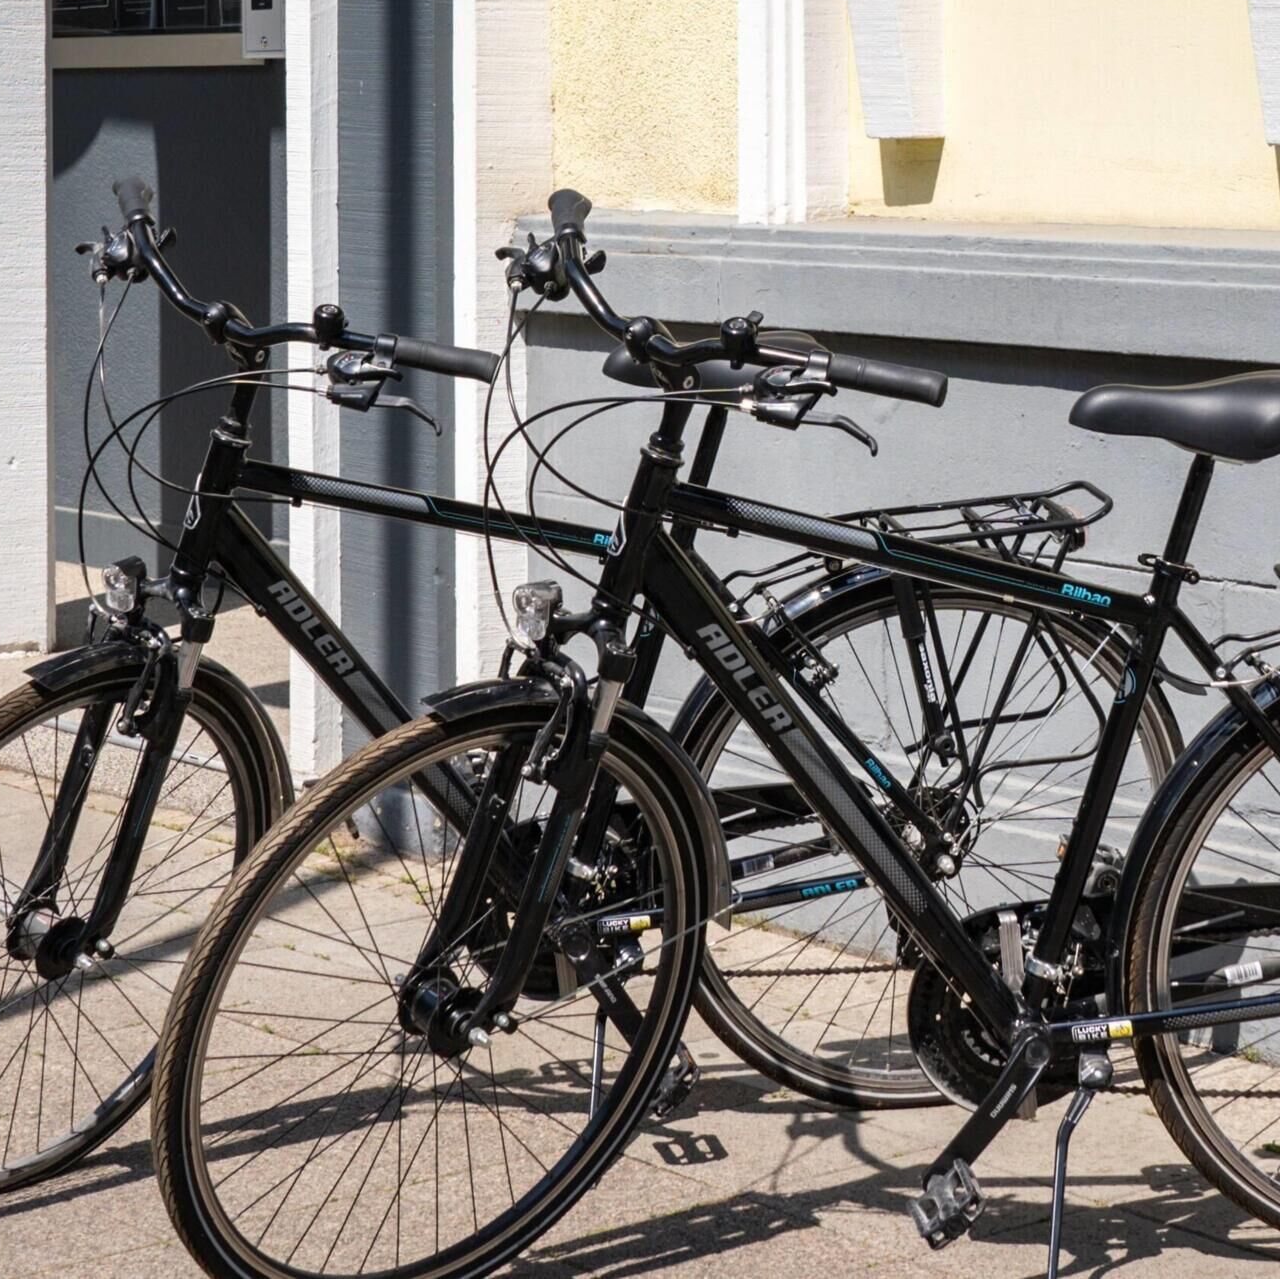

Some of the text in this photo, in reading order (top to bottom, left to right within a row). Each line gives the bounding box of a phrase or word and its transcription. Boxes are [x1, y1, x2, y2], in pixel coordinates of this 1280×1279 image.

[1061, 583, 1112, 607] Rilhan
[266, 579, 355, 677] ADLER
[695, 622, 794, 733] ADLER
[918, 642, 938, 704] saxonia
[864, 758, 892, 790] Rilhan
[801, 879, 859, 898] ADLER
[1077, 1024, 1107, 1033] LUCKY
[1078, 1031, 1107, 1041] BIKE
